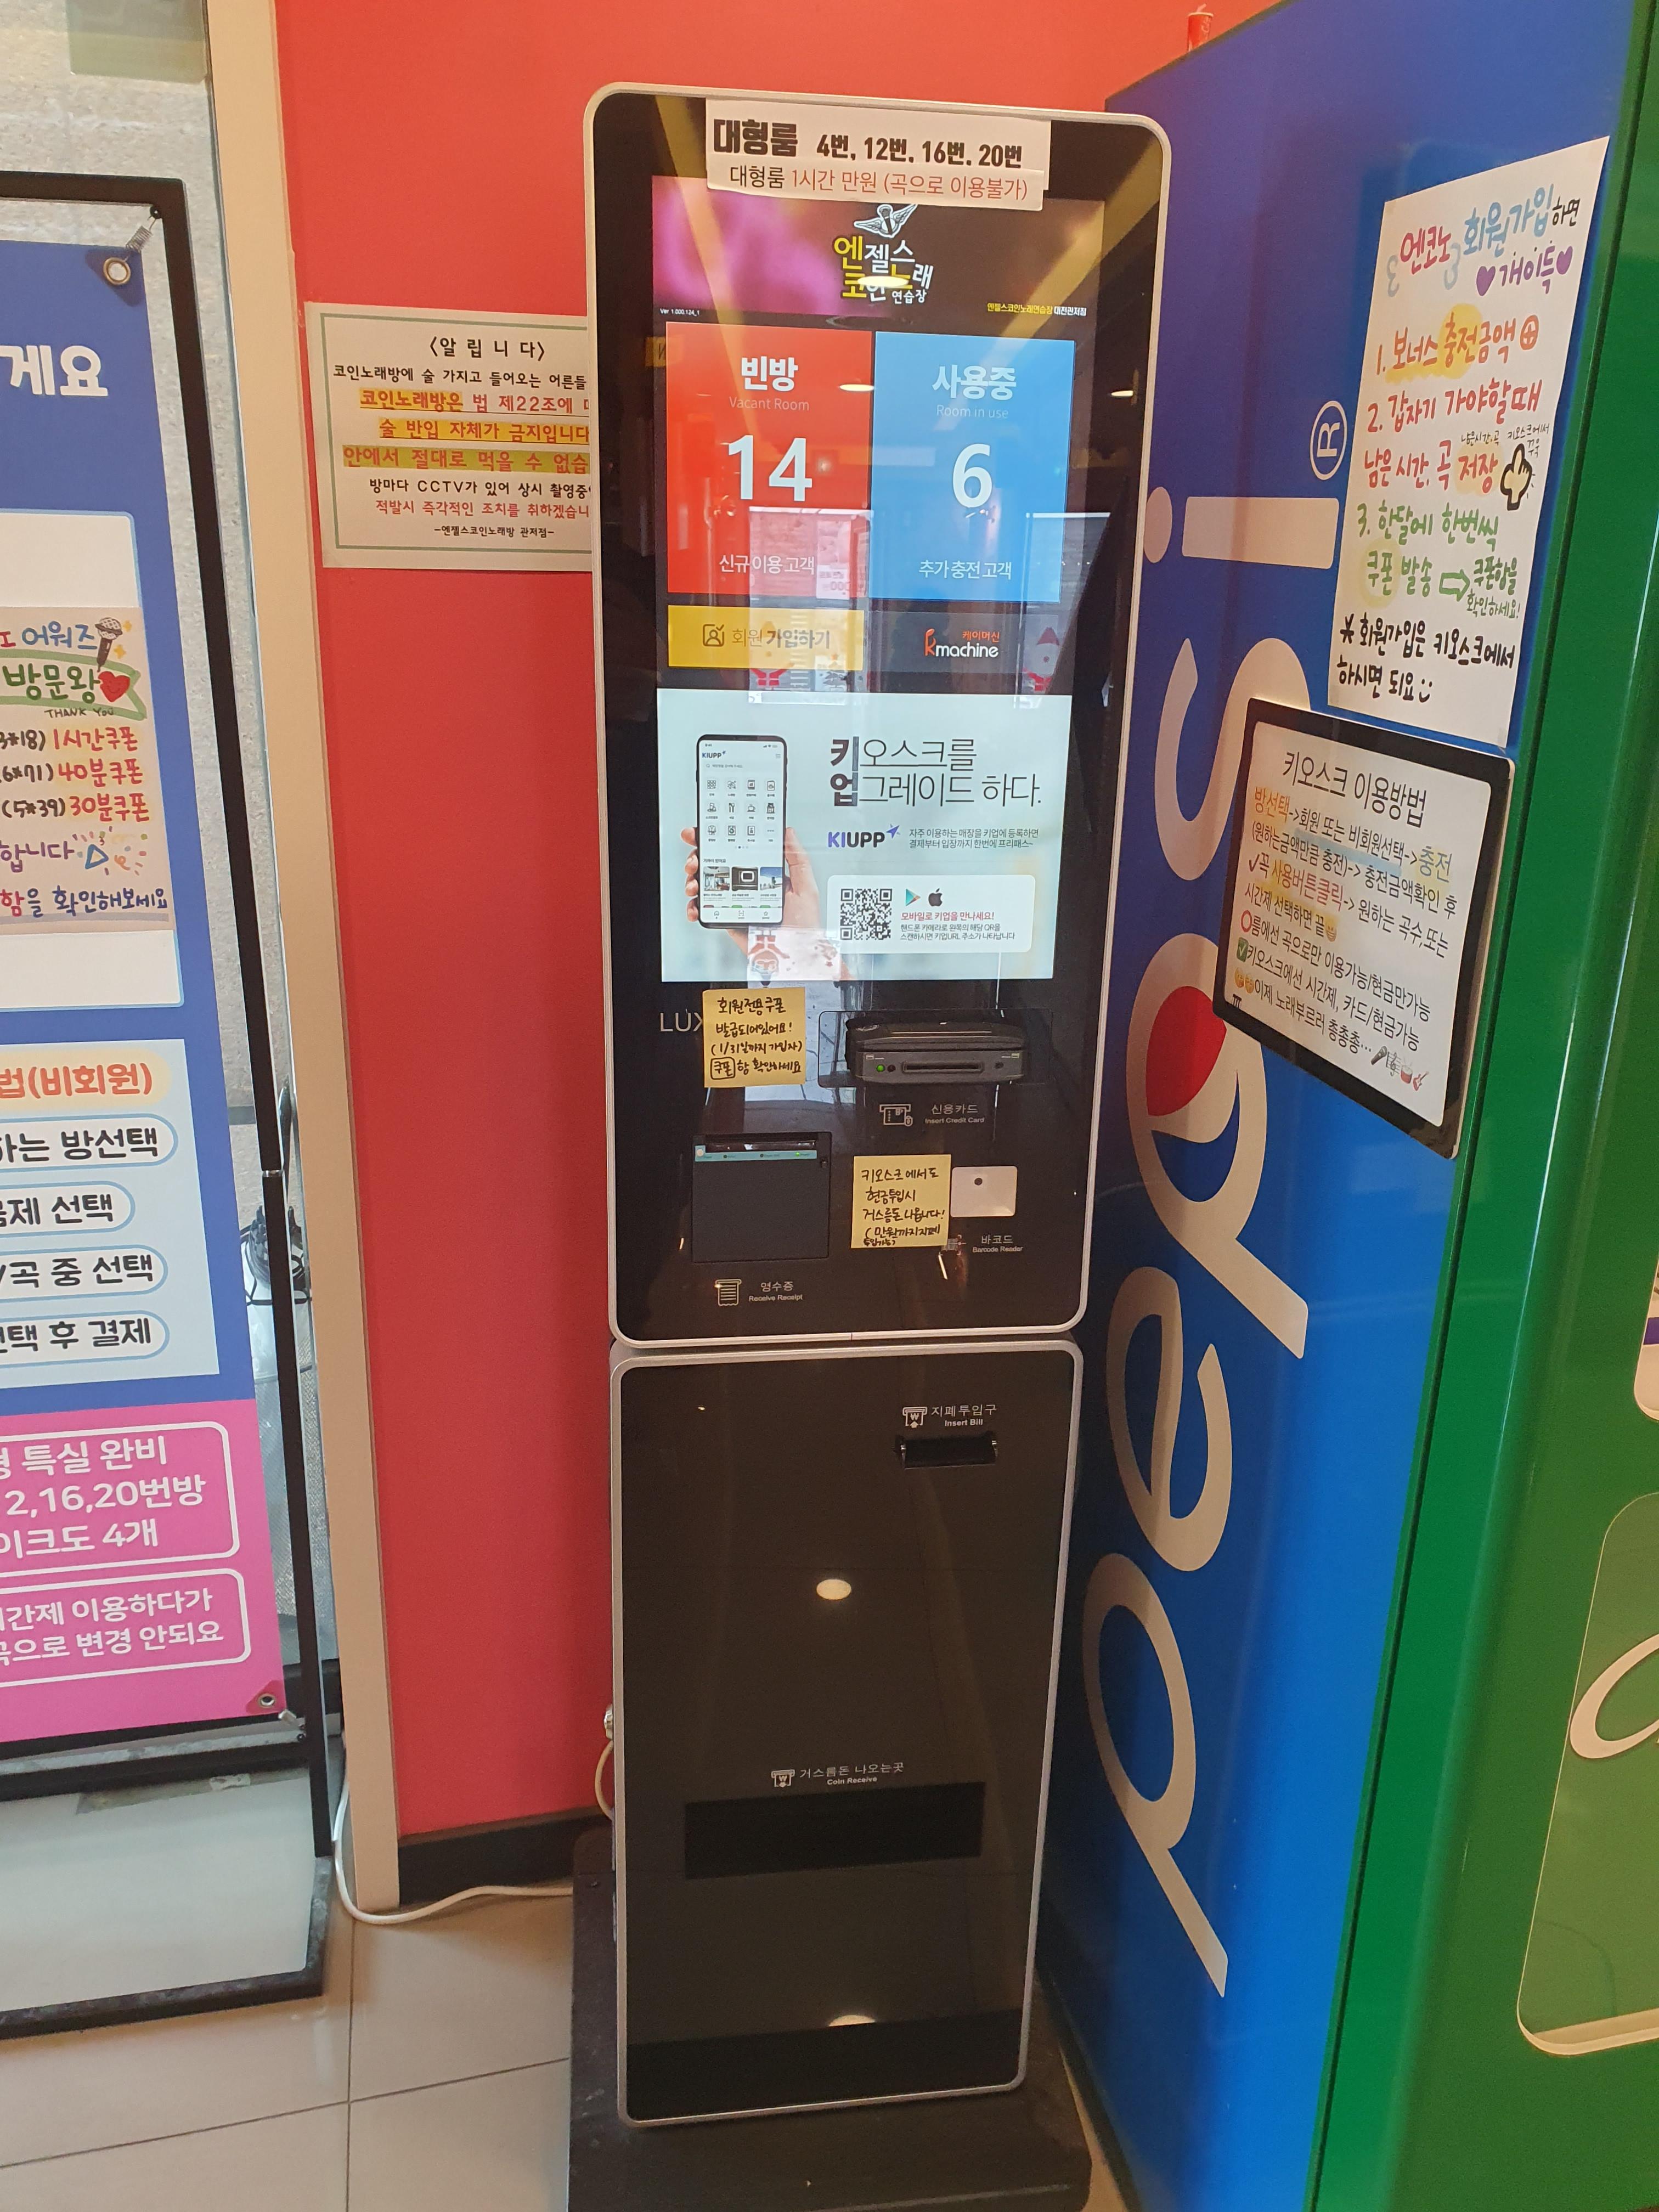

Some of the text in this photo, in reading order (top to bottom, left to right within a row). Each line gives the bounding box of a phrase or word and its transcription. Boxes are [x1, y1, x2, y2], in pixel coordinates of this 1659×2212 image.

[714, 119, 798, 157] 대형룸
[816, 134, 856, 161] 4번,
[979, 144, 1022, 168] 20번
[730, 165, 1027, 201] 대형룸 1시간 만원 (곡으로 이용불가)
[834, 236, 915, 273] 엔젤스
[1499, 240, 1555, 294] 개이득
[892, 289, 927, 304] 연습장
[1392, 312, 1516, 370] 보너스 충전금액
[0, 345, 109, 397] 게요
[333, 365, 587, 390] 코인노래방에 술 가지고 들어오는 어른들
[742, 356, 799, 392] 빈방
[932, 365, 1018, 401] 사용중
[360, 390, 464, 413] 코인노래방은
[473, 394, 488, 413] 법
[499, 395, 573, 414] 제22조에
[729, 397, 809, 411] Vacant Room
[936, 405, 1008, 419] Room in use
[1368, 390, 1436, 433] 2. 갑자기
[379, 418, 589, 443] 술 반입 자체가 금지입니다
[343, 447, 399, 467] 안에서
[411, 449, 467, 469] 절대로
[478, 451, 514, 472] 먹을
[525, 453, 543, 470] 수
[728, 435, 812, 502] 14
[952, 444, 992, 508] 6
[1364, 439, 1499, 493] 남은 곡 저장
[370, 478, 543, 498] 방마다 CCTV가 있어 상시
[376, 500, 415, 516] 적발시
[422, 501, 473, 517] 즉각적인
[481, 503, 520, 518] 조치를
[1378, 499, 1499, 552] 한달에 한번씩
[785, 557, 814, 575] 고객
[919, 560, 1012, 580] 추가 충전 고객
[1367, 550, 1433, 597] 쿠폰 발송
[21, 620, 98, 651] 어워즈
[732, 628, 830, 650] 회원 가입하기
[962, 630, 1000, 642] 케이머신
[1359, 612, 1516, 669] 회원가입은 키오스크에서
[2, 663, 100, 704] 방문왕
[1336, 654, 1414, 701] 하시면 되요
[44, 708, 87, 718] THANK
[53, 726, 138, 752] 1시간쿠폰
[830, 736, 977, 772] 키오스크를
[58, 758, 144, 788] 40분쿠폰
[830, 772, 1041, 807] 업그레이드 하다.
[1282, 751, 1427, 828] 키오스크 이용방법
[69, 793, 150, 823] 30분쿠폰
[828, 832, 885, 848] KIUPP
[909, 828, 1039, 839] 자주 이용하는 매장을 키업에 등록하면
[910, 839, 997, 849] 결제부터 입장까지 한번에
[1321, 816, 1345, 843] 또는
[53, 884, 167, 917] 확인해보세요
[1365, 865, 1440, 913] 충전금액확인
[1444, 895, 1457, 919] 후
[901, 911, 994, 921] 모바일로 키업을 만나세요!
[1245, 883, 1325, 938] 시간제 선택하면 끝
[1358, 899, 1395, 933] 원하는
[1251, 915, 1322, 967] 룸에선 곡으로만
[1247, 945, 1303, 991] 키오스크에선
[1255, 979, 1325, 1035] 이제 노래부르러
[932, 1104, 979, 1115] 신용카드
[60, 1127, 158, 1160] 방선택
[52, 1193, 114, 1224] 선택
[981, 1234, 1013, 1245] 바코드
[50, 1254, 153, 1287] 중 선택
[760, 1281, 794, 1293] 영수증
[48, 1318, 151, 1349] 후 결제
[931, 1404, 997, 1417] 지폐투입구
[21, 1441, 91, 1476] 특실
[99, 1435, 167, 1471] 완비
[5, 1474, 206, 1518] 2,16,20번방
[102, 1519, 159, 1548] 4개
[72, 1588, 213, 1623] 이용하다가
[76, 1620, 224, 1658] 변경 안되요
[799, 1762, 904, 1779] 거스름돈 나오는곳
[847, 1776, 877, 1784] Receive
